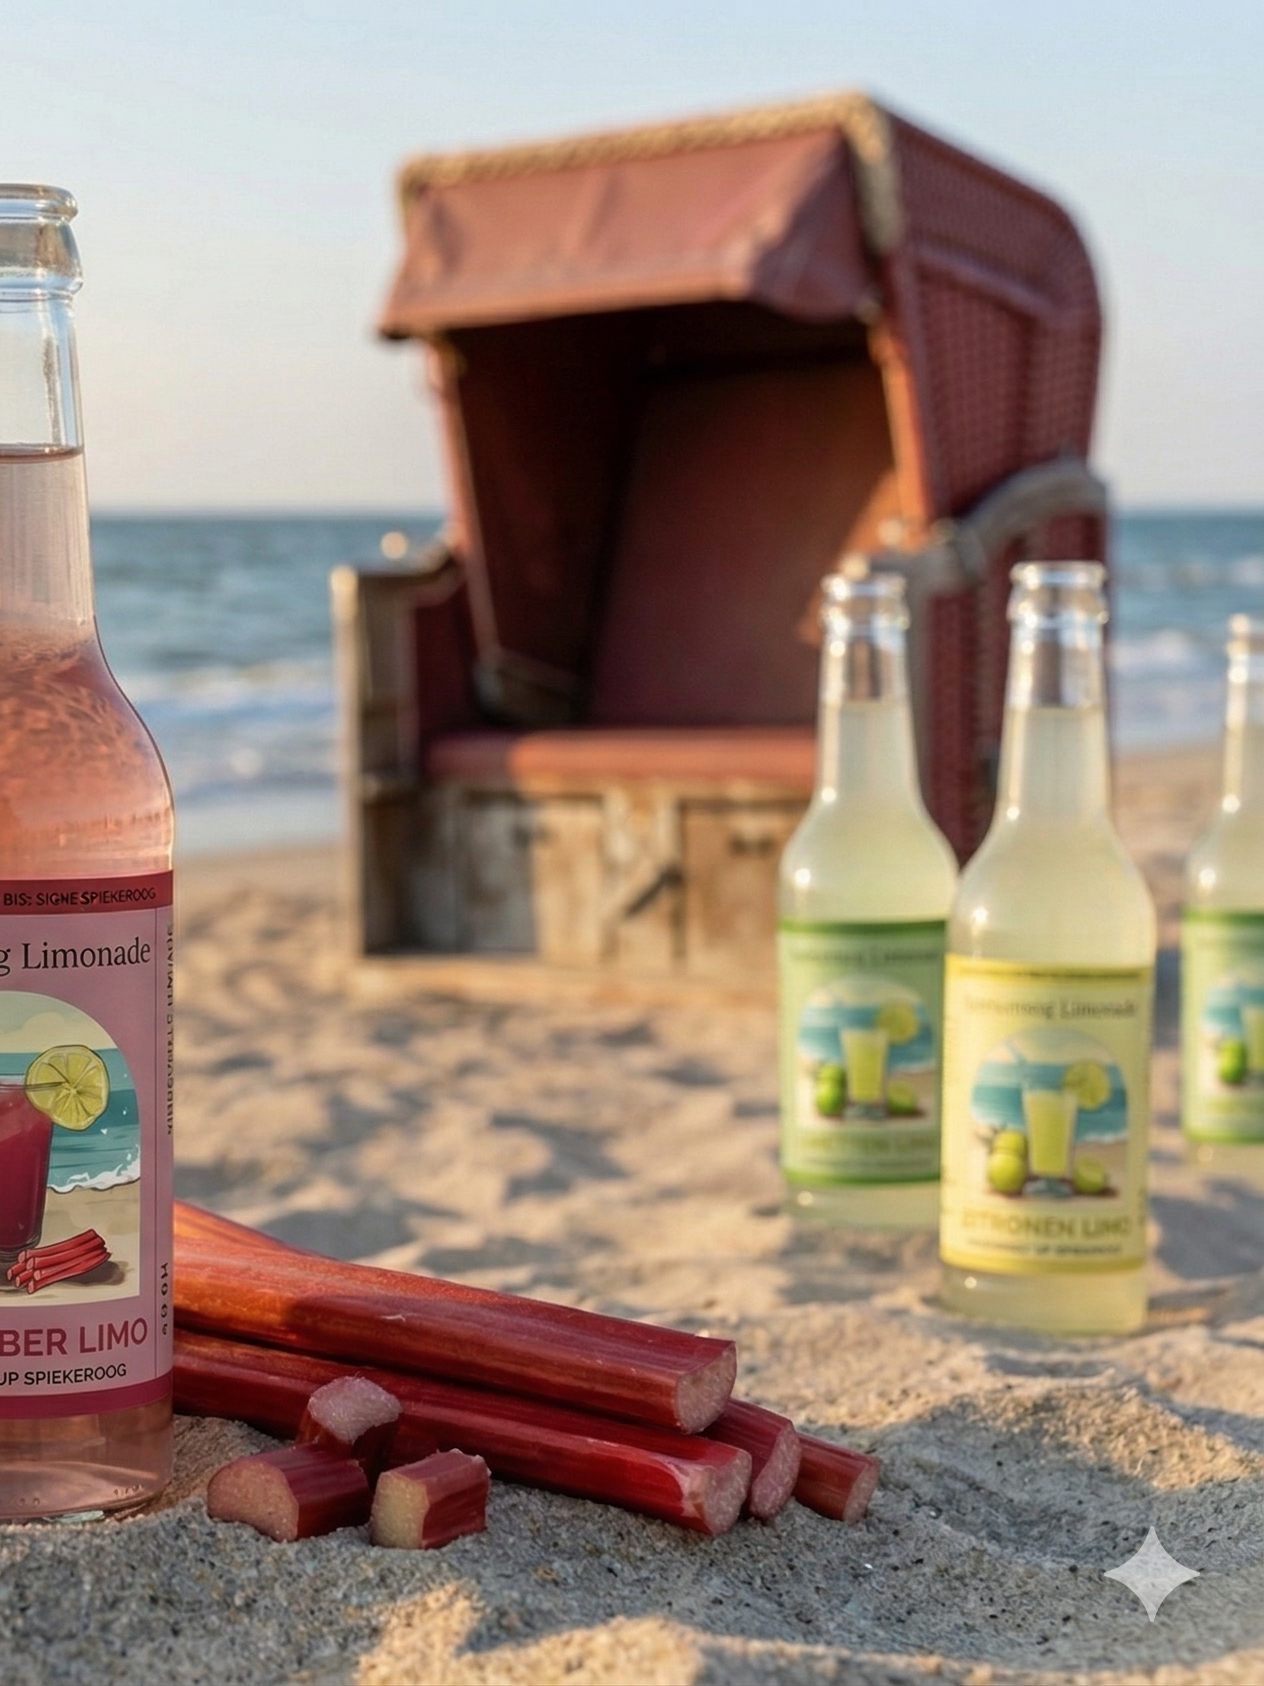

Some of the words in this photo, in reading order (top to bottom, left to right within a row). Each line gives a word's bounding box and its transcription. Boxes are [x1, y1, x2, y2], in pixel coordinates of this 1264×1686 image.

[80, 887, 156, 905] SPIEKEROOG
[21, 936, 152, 971] Limonade
[79, 1317, 148, 1354] LIMO
[23, 1363, 127, 1385] SPIEKEROOG
